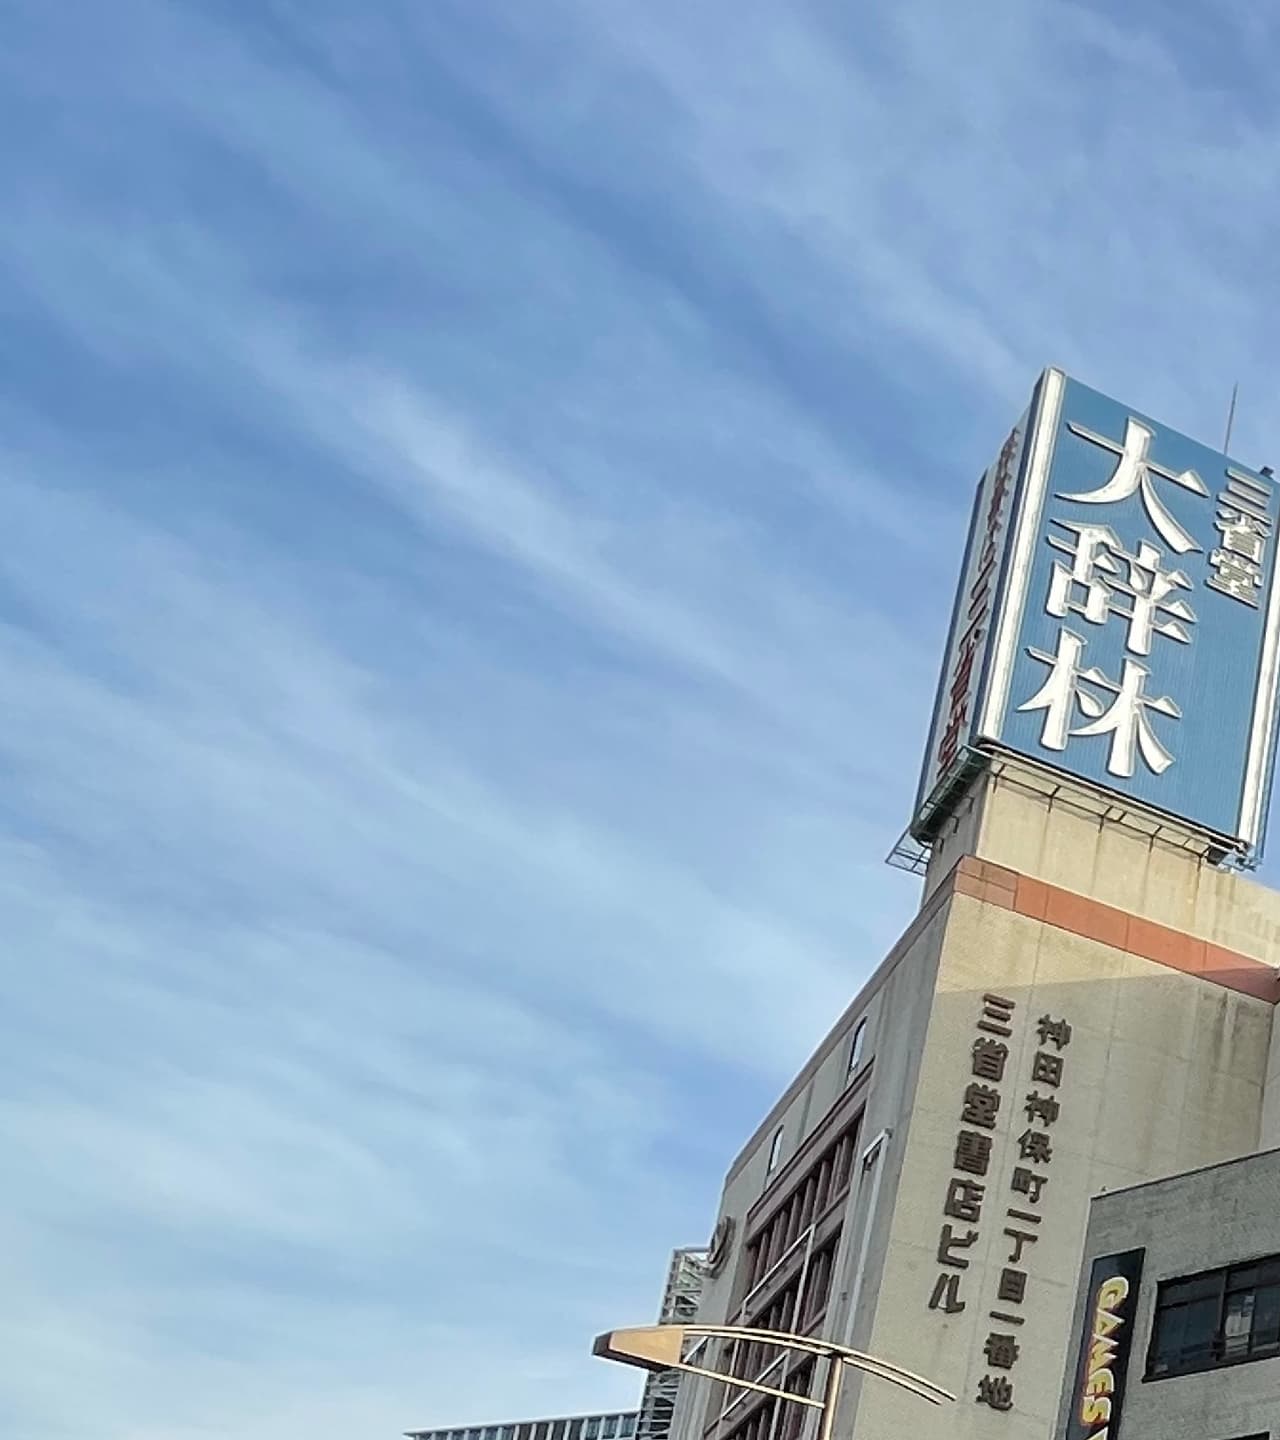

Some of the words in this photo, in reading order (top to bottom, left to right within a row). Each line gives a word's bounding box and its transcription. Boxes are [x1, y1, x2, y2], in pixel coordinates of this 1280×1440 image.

[1016, 416, 1210, 778] 大辞林
[1204, 466, 1273, 608] 三省堂
[928, 993, 1017, 1315] 三省堂書店ビル
[976, 1012, 1072, 1412] 神田神保町一丁目一番地
[1081, 1274, 1130, 1424] GAMES
